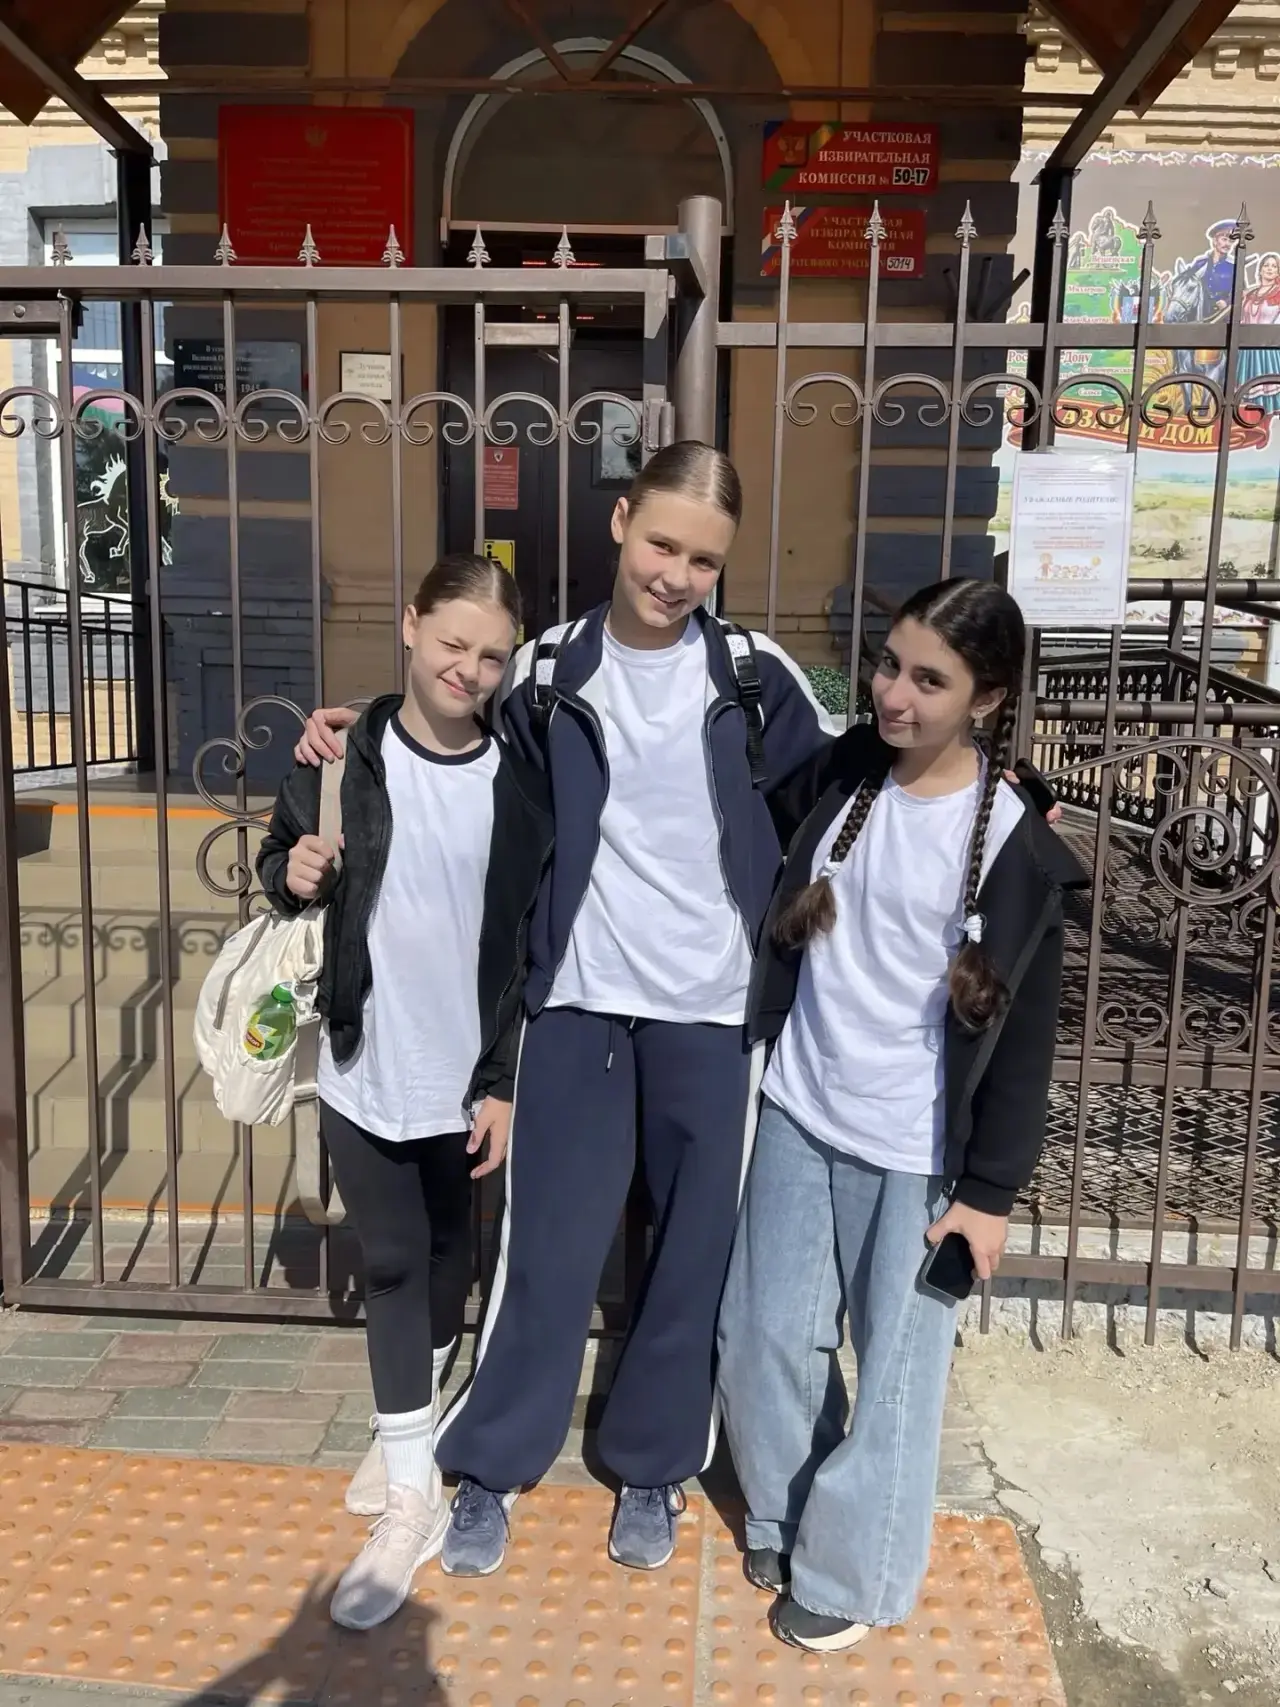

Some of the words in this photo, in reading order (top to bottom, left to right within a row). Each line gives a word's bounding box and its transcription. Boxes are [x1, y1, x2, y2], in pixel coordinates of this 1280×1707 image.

[843, 131, 932, 144] УЧАСТКОВАЯ
[819, 151, 930, 164] ИЗБИРАТЕЛЬНАЯ
[799, 172, 876, 185] КОМИССИЯ
[894, 169, 929, 184] 50-17
[888, 258, 912, 269] 5014
[1160, 423, 1214, 445] ДОМ
